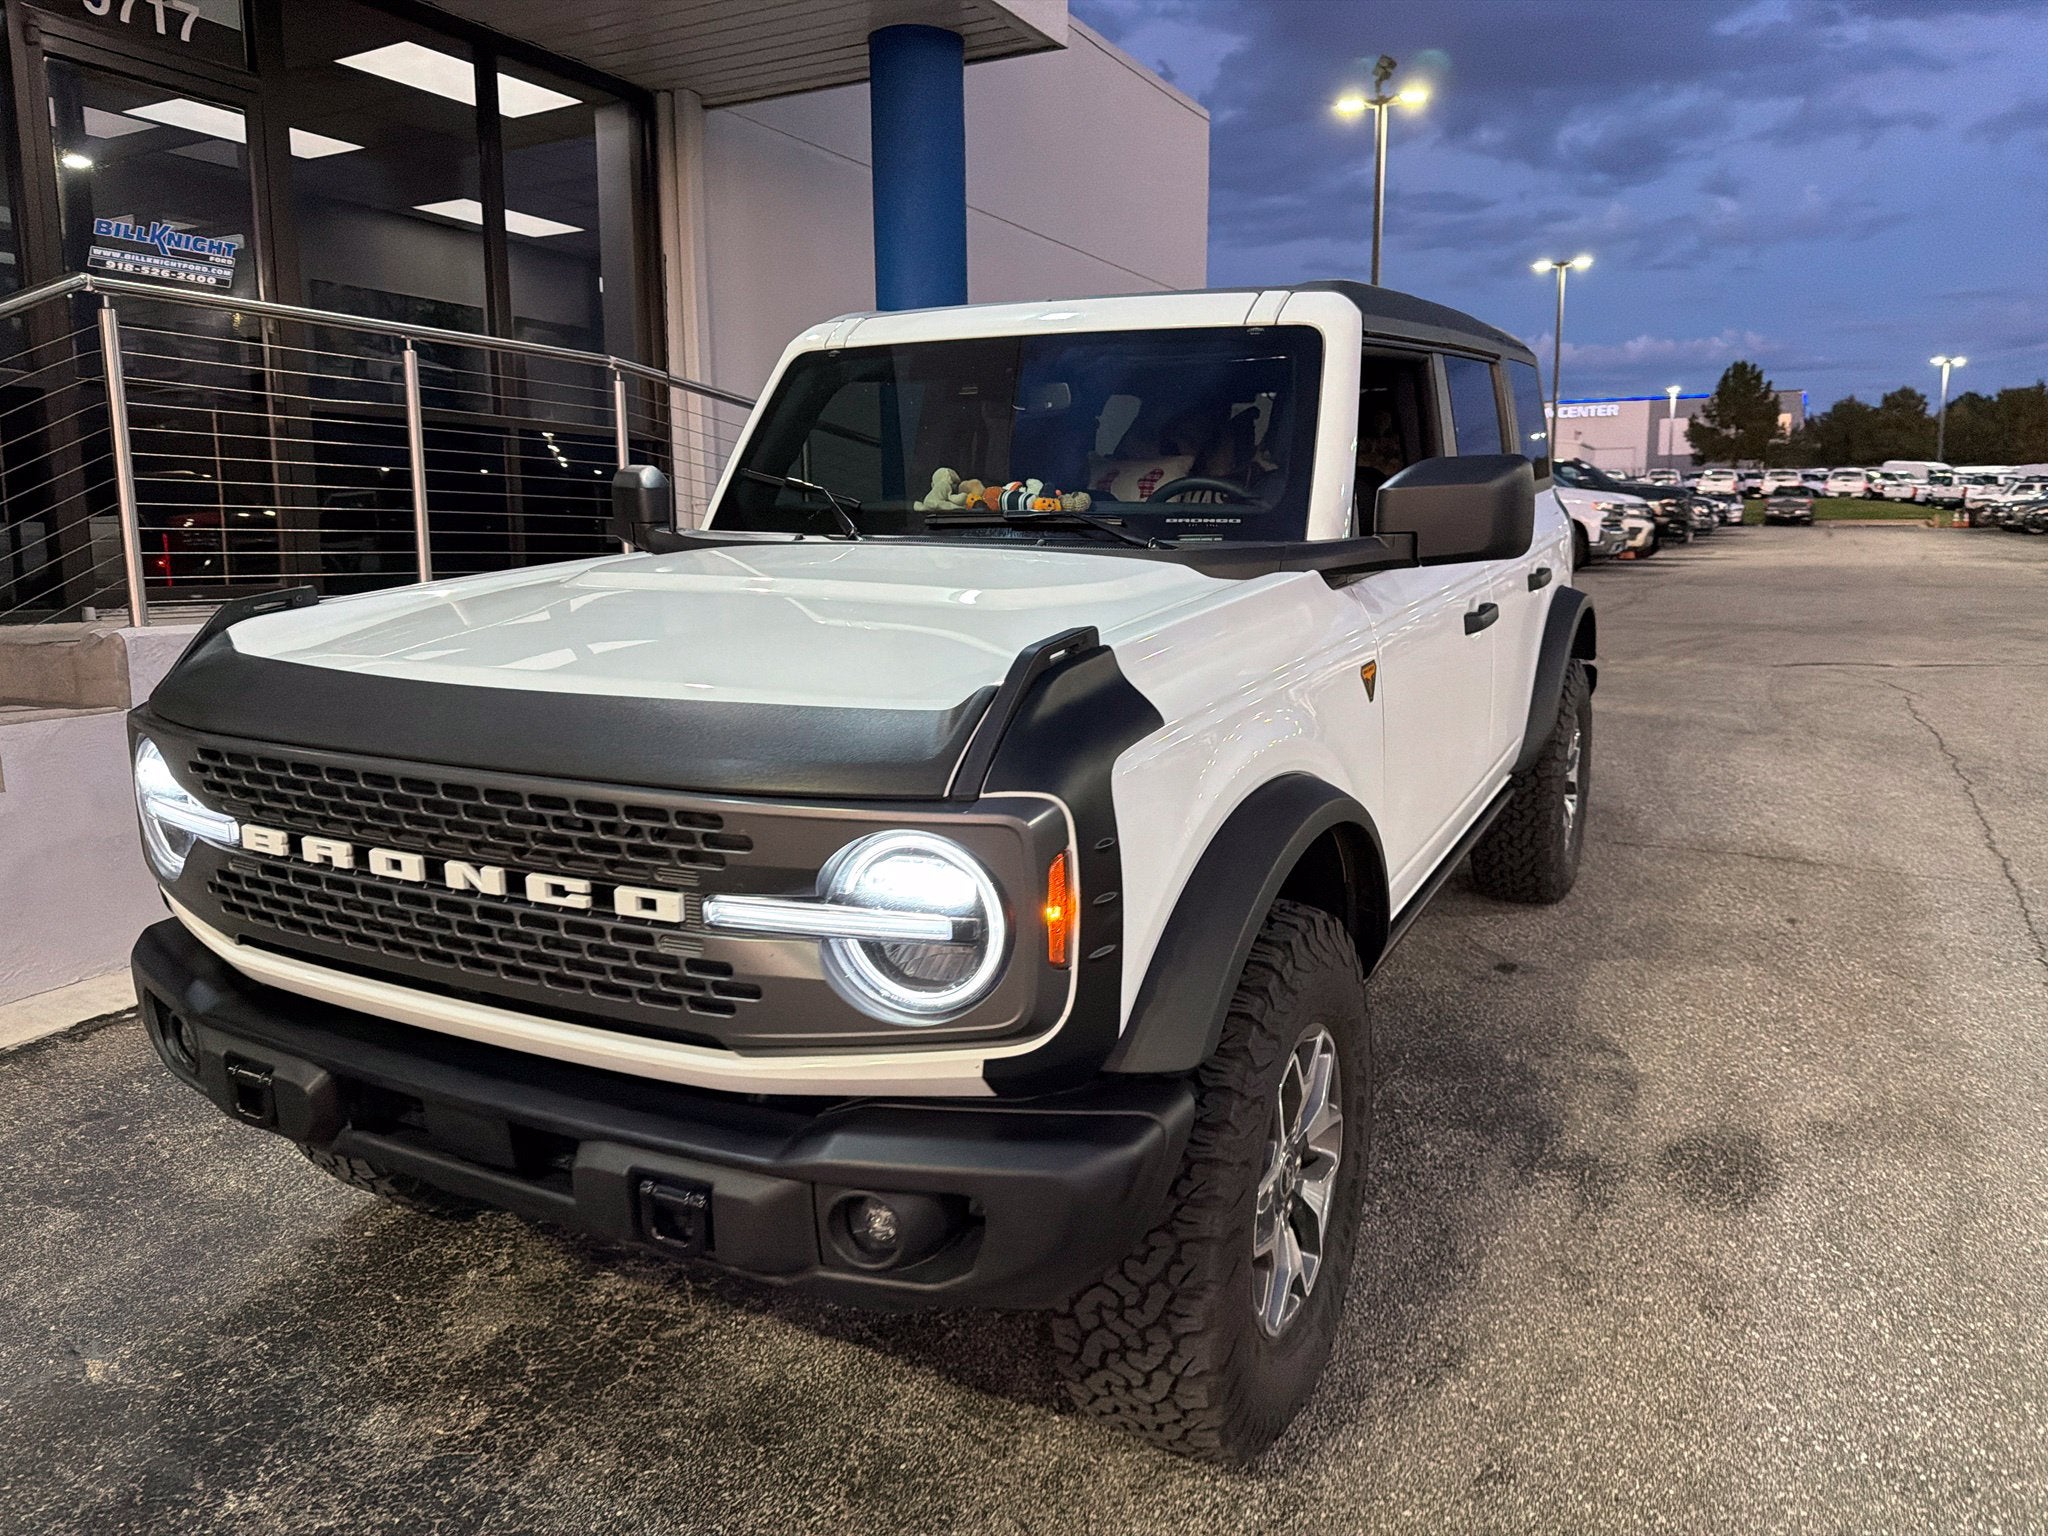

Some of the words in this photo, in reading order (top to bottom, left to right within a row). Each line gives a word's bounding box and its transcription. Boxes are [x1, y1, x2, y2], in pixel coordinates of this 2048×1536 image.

[93, 249, 232, 276] WWW.BILLKNIGHTFORD.COM
[105, 260, 217, 285] 918-526-2400
[209, 256, 233, 265] FORD
[1557, 404, 1620, 418] CENTER
[240, 823, 686, 923] BRONCO
